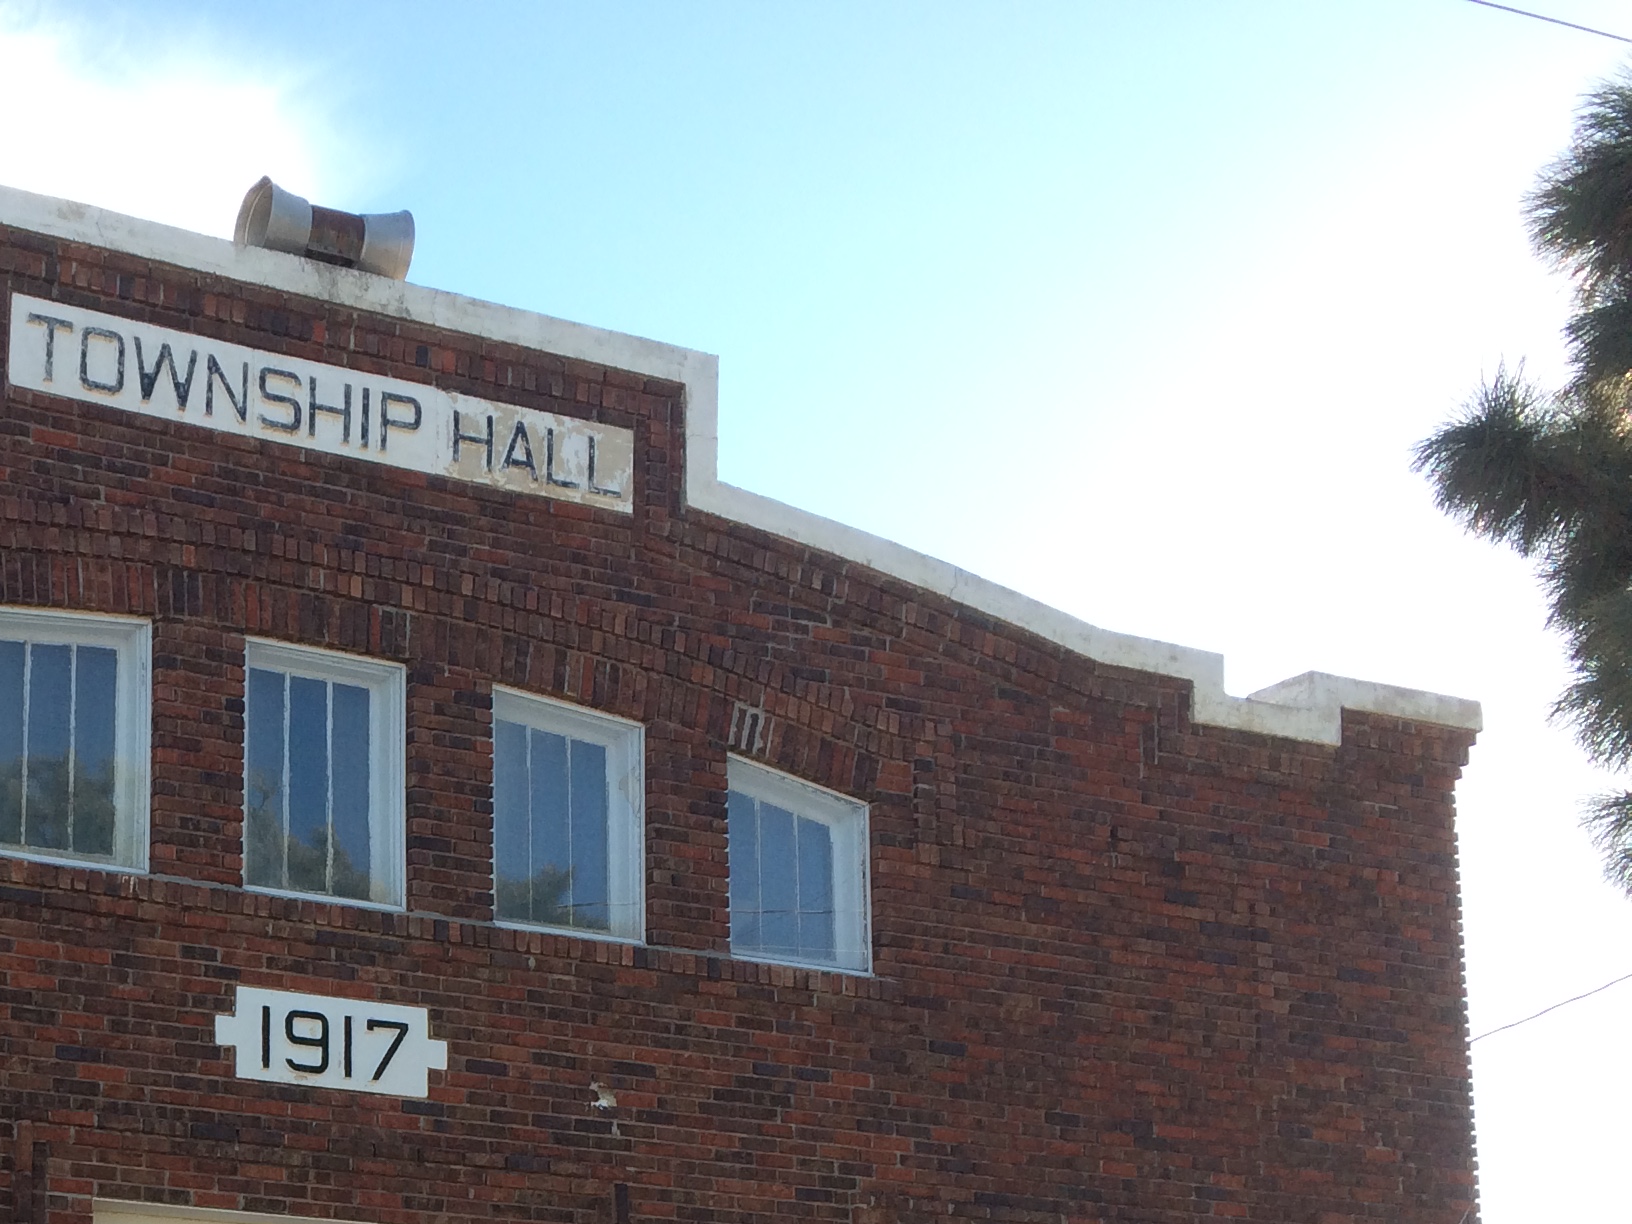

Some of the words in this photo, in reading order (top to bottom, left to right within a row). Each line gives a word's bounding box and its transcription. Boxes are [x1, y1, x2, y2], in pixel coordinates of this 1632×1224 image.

[28, 312, 422, 453] TOWNSHIP
[453, 408, 621, 498] HALL
[262, 1005, 409, 1080] 1917
